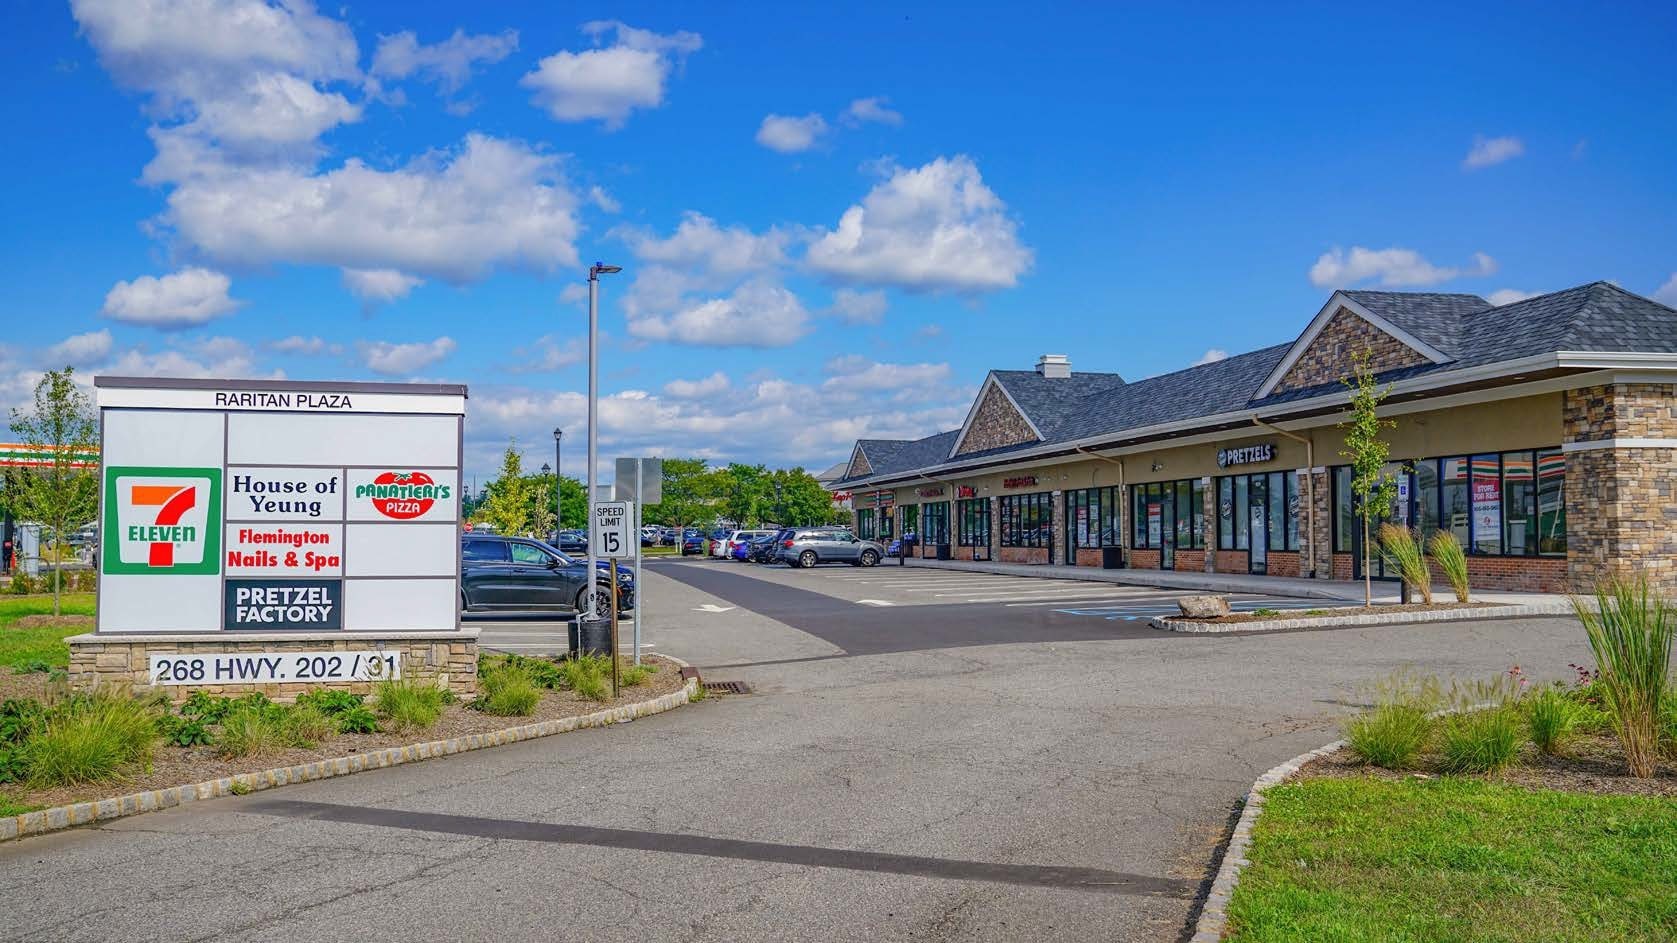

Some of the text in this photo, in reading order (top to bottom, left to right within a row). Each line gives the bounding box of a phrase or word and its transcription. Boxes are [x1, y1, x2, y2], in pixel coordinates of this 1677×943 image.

[215, 392, 353, 409] RARITAN PLAZA
[1227, 445, 1271, 464] PRETZELS
[233, 475, 338, 494] House of
[355, 483, 451, 499] PANATIERI'S
[249, 495, 322, 517] Yeung
[1473, 493, 1485, 501] FOR
[386, 502, 421, 513] PIZZA
[597, 507, 624, 516] SPEED
[600, 517, 621, 527] LIMIT
[239, 528, 330, 548] Flemington
[602, 532, 620, 553] 15
[228, 550, 340, 572] Nails & Spa
[236, 587, 333, 605] PRETZEL
[236, 605, 333, 623] FACTORY
[156, 659, 205, 681] 268
[215, 657, 286, 680] HWY.
[295, 656, 342, 679] 202
[368, 654, 395, 677] 31
